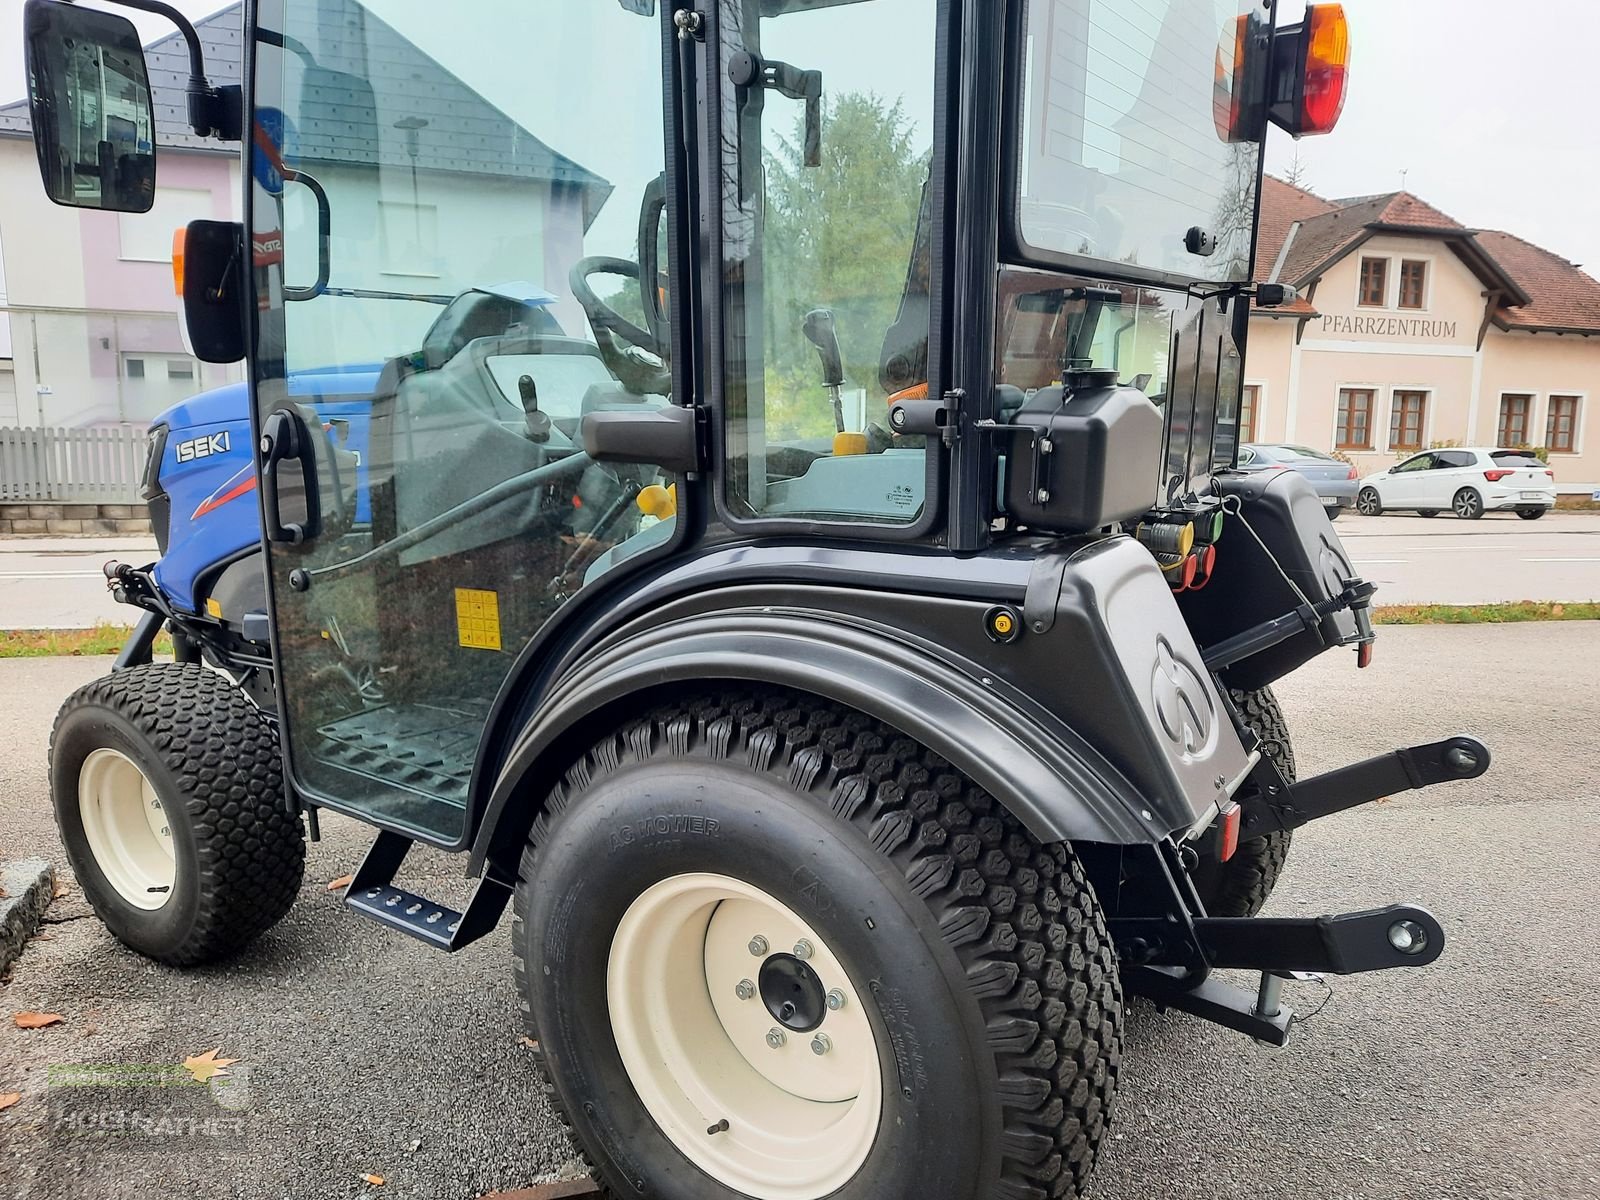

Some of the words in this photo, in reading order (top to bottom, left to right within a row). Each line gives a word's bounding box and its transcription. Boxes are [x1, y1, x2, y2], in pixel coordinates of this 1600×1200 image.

[1322, 314, 1457, 338] PFARRZENTRUM
[175, 431, 231, 464] ISEKI
[608, 825, 635, 852] AG
[639, 815, 720, 838] MOWER
